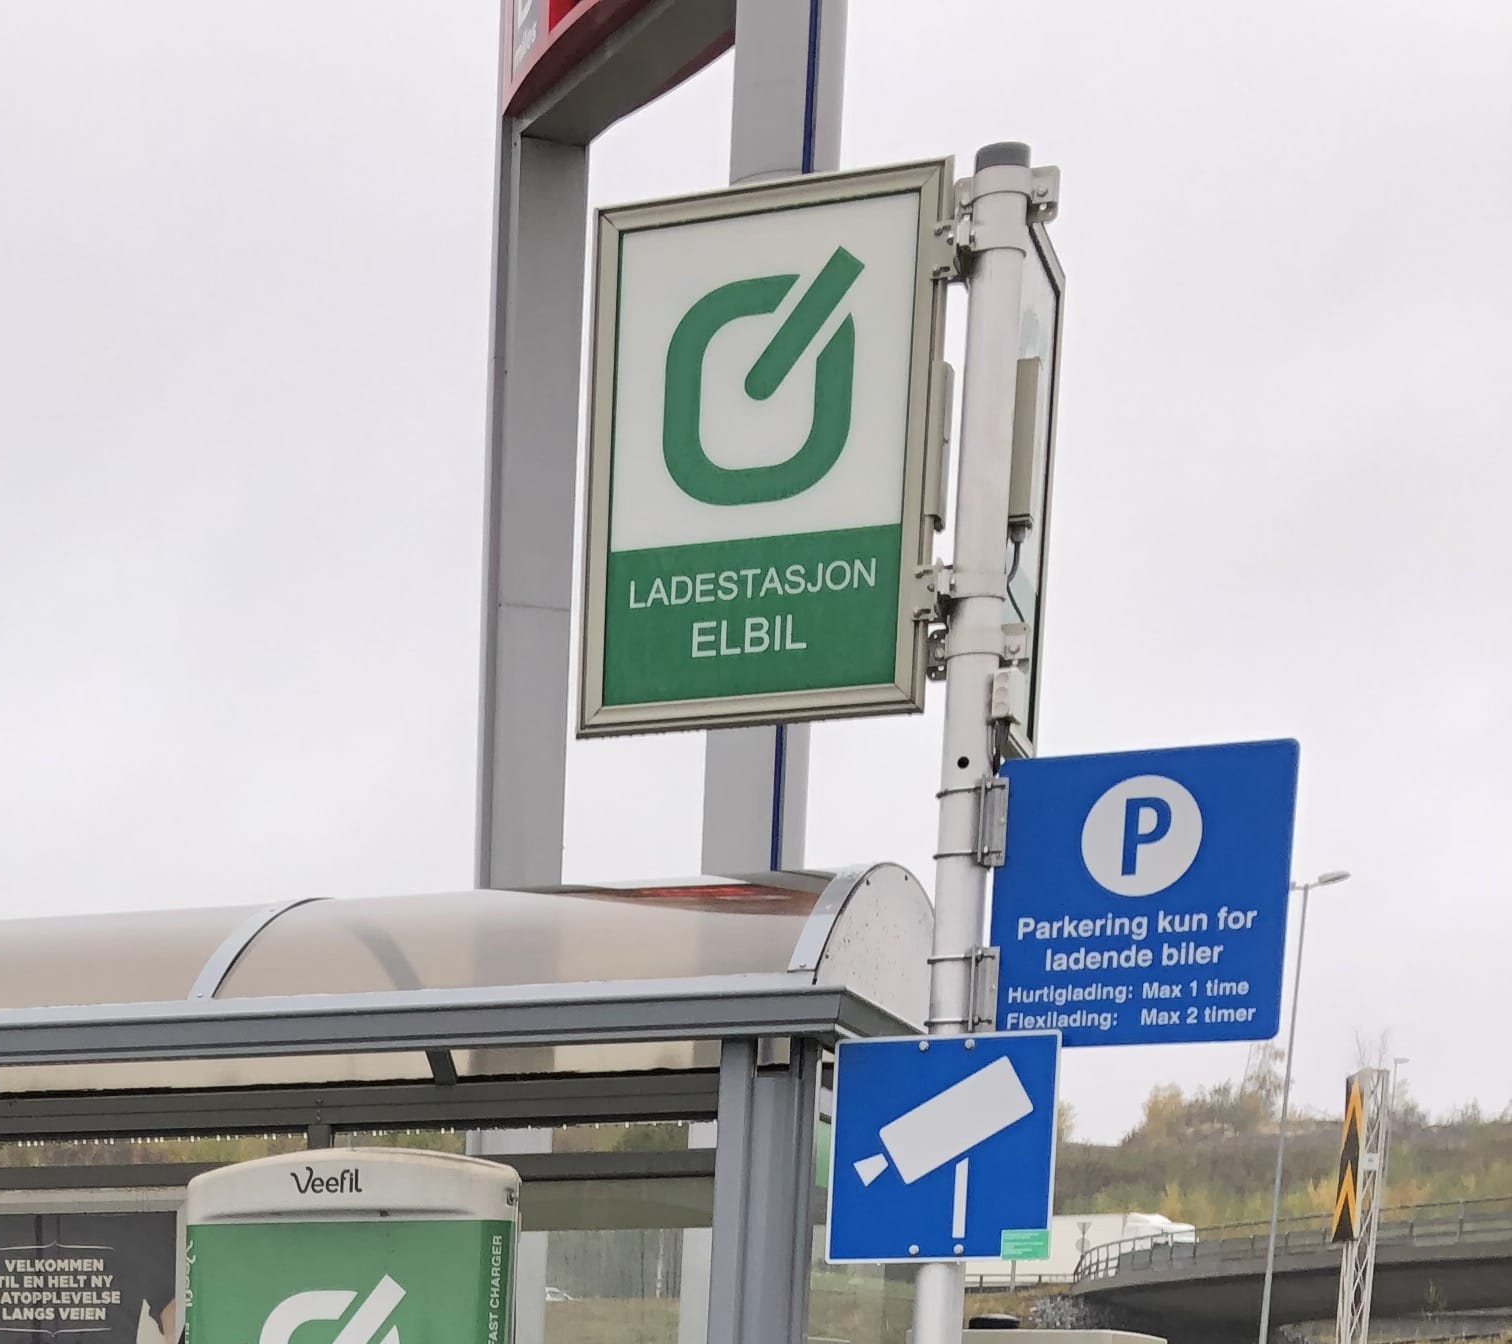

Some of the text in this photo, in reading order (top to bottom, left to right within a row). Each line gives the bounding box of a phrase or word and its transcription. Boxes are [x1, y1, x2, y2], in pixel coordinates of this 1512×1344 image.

[629, 557, 877, 609] LADESTASJON
[691, 613, 807, 658] ELBIL
[1121, 797, 1172, 876] P
[1017, 906, 1258, 941] Parkering kun for
[1045, 941, 1224, 971] ladende biler
[1007, 979, 1250, 1005] Hurtiglading: Max 1 time
[1140, 1008, 1181, 1026] Max
[1186, 1007, 1198, 1024] 2
[1203, 1006, 1257, 1024] timer
[290, 1166, 363, 1194] Veefil
[4, 1259, 104, 1273] VELKOMMEN
[490, 1235, 503, 1308] CHARGER
[23, 1275, 44, 1288] EN
[48, 1275, 87, 1288] HELT
[90, 1274, 114, 1288] NY
[2, 1307, 106, 1321] LANGS VEIEN
